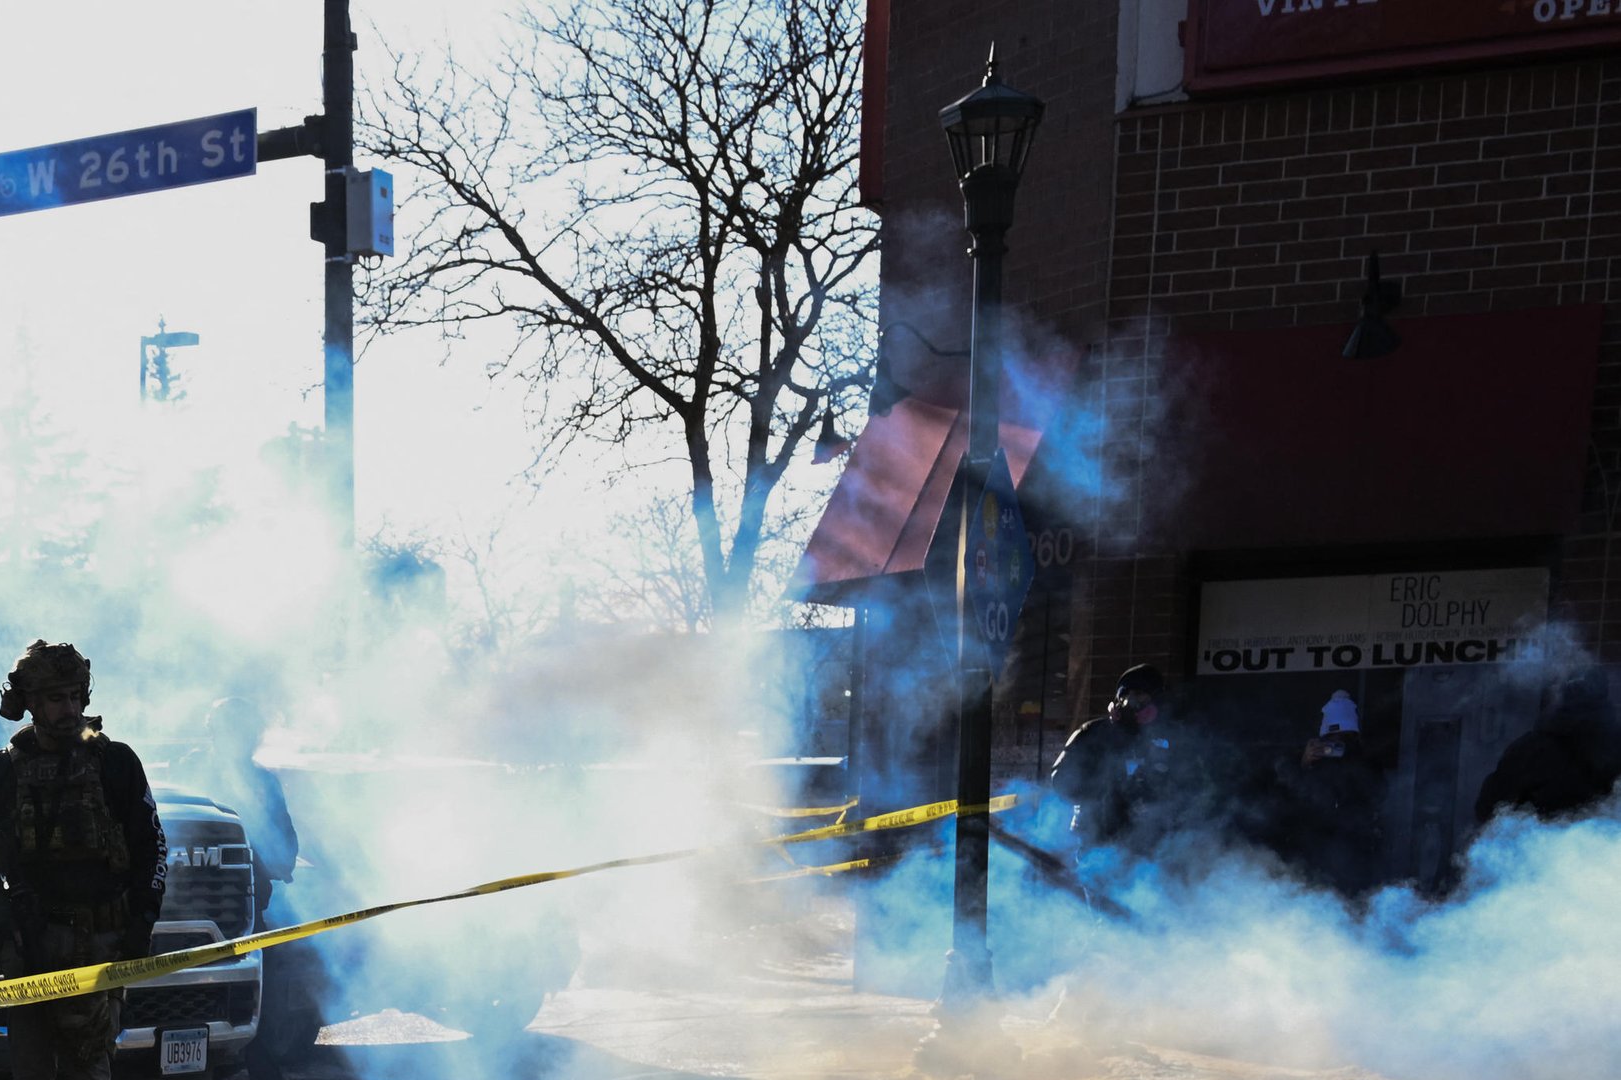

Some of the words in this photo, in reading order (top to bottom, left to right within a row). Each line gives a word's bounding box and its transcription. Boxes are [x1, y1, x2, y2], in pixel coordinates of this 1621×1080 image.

[1533, 0, 1621, 22] OPE
[28, 159, 55, 197] W
[79, 140, 177, 189] 26th
[201, 126, 245, 168] St
[1390, 575, 1441, 602] ERIC
[986, 601, 1009, 641] GO
[1402, 599, 1490, 628] DOLPHY
[1204, 647, 1295, 672] 'OUT
[1307, 644, 1363, 668] TO
[167, 1041, 202, 1065] UB3976
